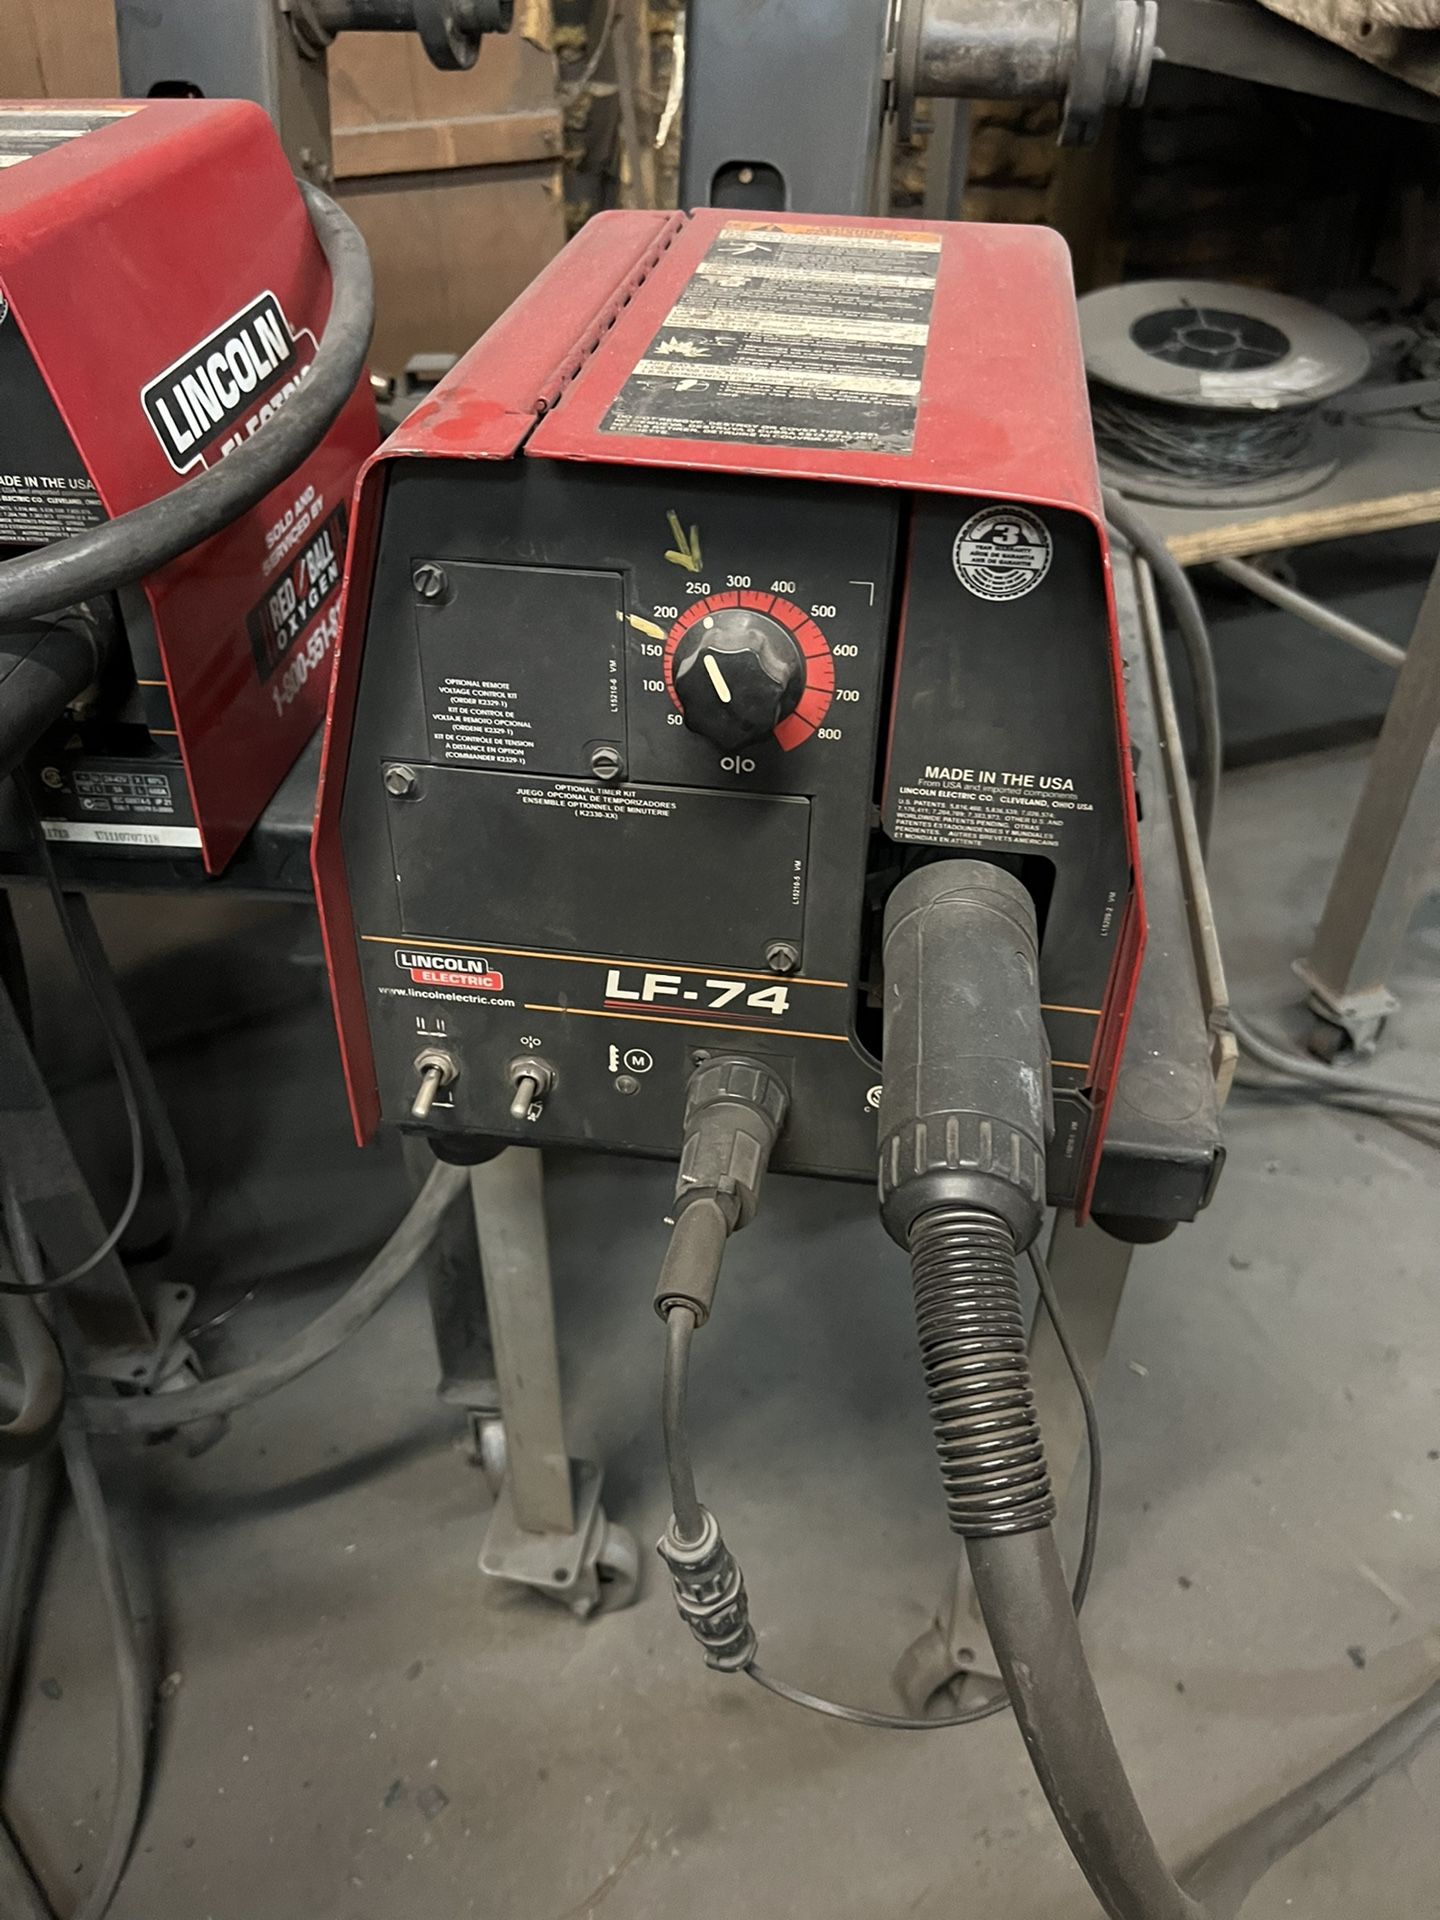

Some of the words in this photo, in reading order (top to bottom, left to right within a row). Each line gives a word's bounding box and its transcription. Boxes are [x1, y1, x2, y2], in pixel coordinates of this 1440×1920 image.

[155, 308, 290, 454] LINCOLN
[0, 475, 23, 487] ADE
[24, 476, 39, 488] IN
[39, 476, 67, 489] THE
[68, 478, 96, 490] USA
[310, 494, 324, 521] BY
[265, 509, 294, 550] SOLD
[294, 484, 316, 519] AND
[992, 524, 1020, 545] 3
[268, 576, 296, 633] RED
[305, 530, 335, 586] BALL
[686, 582, 710, 595] 250
[726, 575, 751, 588] 300
[770, 580, 796, 593] 400
[277, 560, 340, 650] OXYGEN
[653, 605, 678, 619] 200
[811, 604, 836, 618] 500
[641, 643, 663, 656] 150
[832, 644, 858, 657] 600
[445, 678, 480, 687] OPTIONAL
[482, 681, 510, 690] REMOTE
[643, 679, 665, 692] 100
[438, 686, 471, 695] VOLTAGE
[472, 690, 506, 698] CONTROL
[835, 689, 860, 702] 700
[450, 696, 477, 704] (ORDER
[470, 708, 504, 717] CONTROL
[432, 713, 461, 722] VOLTAJE
[463, 716, 492, 724] REMOTO
[494, 719, 532, 728] OPCIONAL
[667, 714, 683, 726] 50
[817, 728, 842, 740] 800
[452, 743, 485, 752] DISTANCE
[497, 747, 524, 755] OPTION
[504, 739, 534, 748] TENSION
[917, 778, 941, 787] From
[943, 779, 962, 790] USA
[963, 782, 981, 791] and
[924, 765, 975, 783] MADE
[978, 770, 997, 784] IN
[1001, 772, 1035, 788] THE
[1039, 776, 1075, 792] USA
[555, 784, 595, 794] OPTIONAL
[597, 788, 621, 796] TIMER
[623, 790, 637, 798] KIT
[516, 788, 544, 797] JUEGO
[547, 791, 588, 802] OPCIONAL
[590, 795, 600, 803] DE
[602, 796, 677, 810] TEMPORIZADORES
[899, 787, 937, 797] LINCOLN
[937, 789, 976, 801] ELECTRIC
[999, 796, 1050, 808] CLEVELAND,
[1051, 800, 1075, 810] OHIO
[1076, 803, 1094, 811] USA
[522, 796, 566, 807] ENSEMBLE
[567, 801, 612, 811] OPTIONNEL
[614, 804, 625, 812] DE
[627, 806, 670, 817] MINUTERIE
[400, 953, 483, 973] LINCOLN
[422, 970, 494, 987] ELECTRIC
[378, 987, 516, 1007] www.lincolnelectric.com
[605, 969, 790, 1015] LF-74
